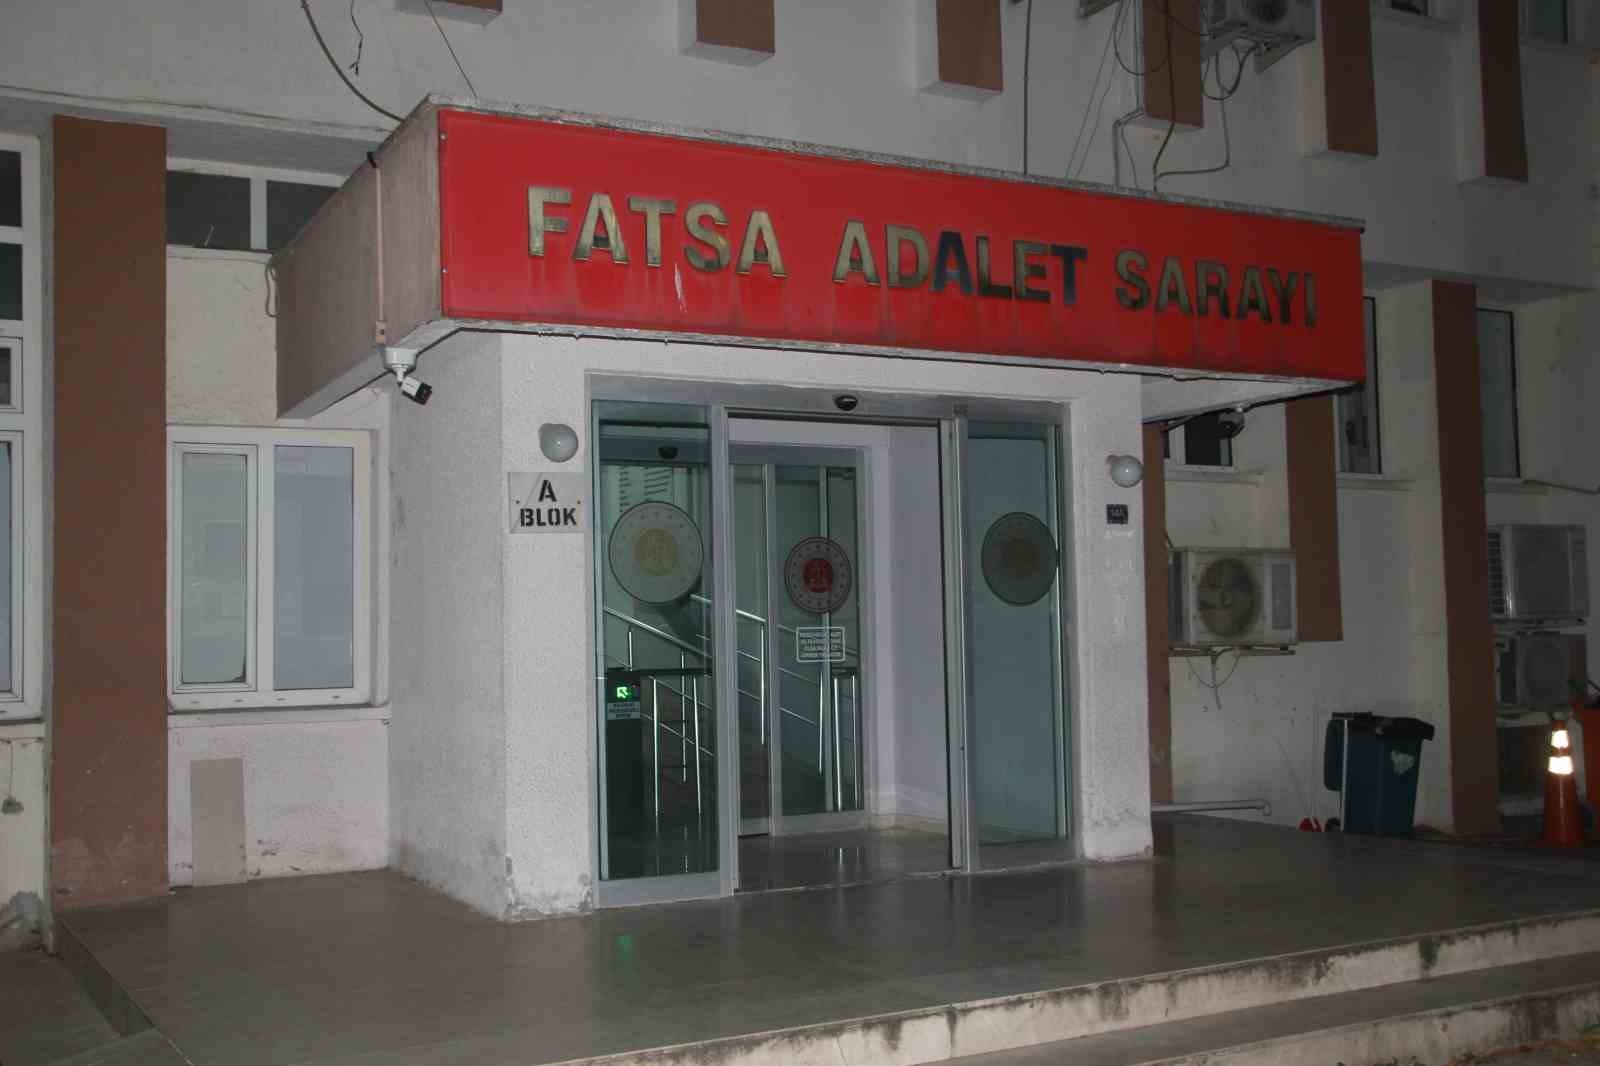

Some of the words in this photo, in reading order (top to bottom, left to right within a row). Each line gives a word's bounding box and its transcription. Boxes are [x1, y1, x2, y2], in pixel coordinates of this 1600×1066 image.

[527, 185, 787, 278] FATSA
[832, 219, 1088, 305] ADALET
[1115, 248, 1318, 328] SARAYI
[538, 479, 558, 502] A
[520, 507, 577, 527] BLOK
